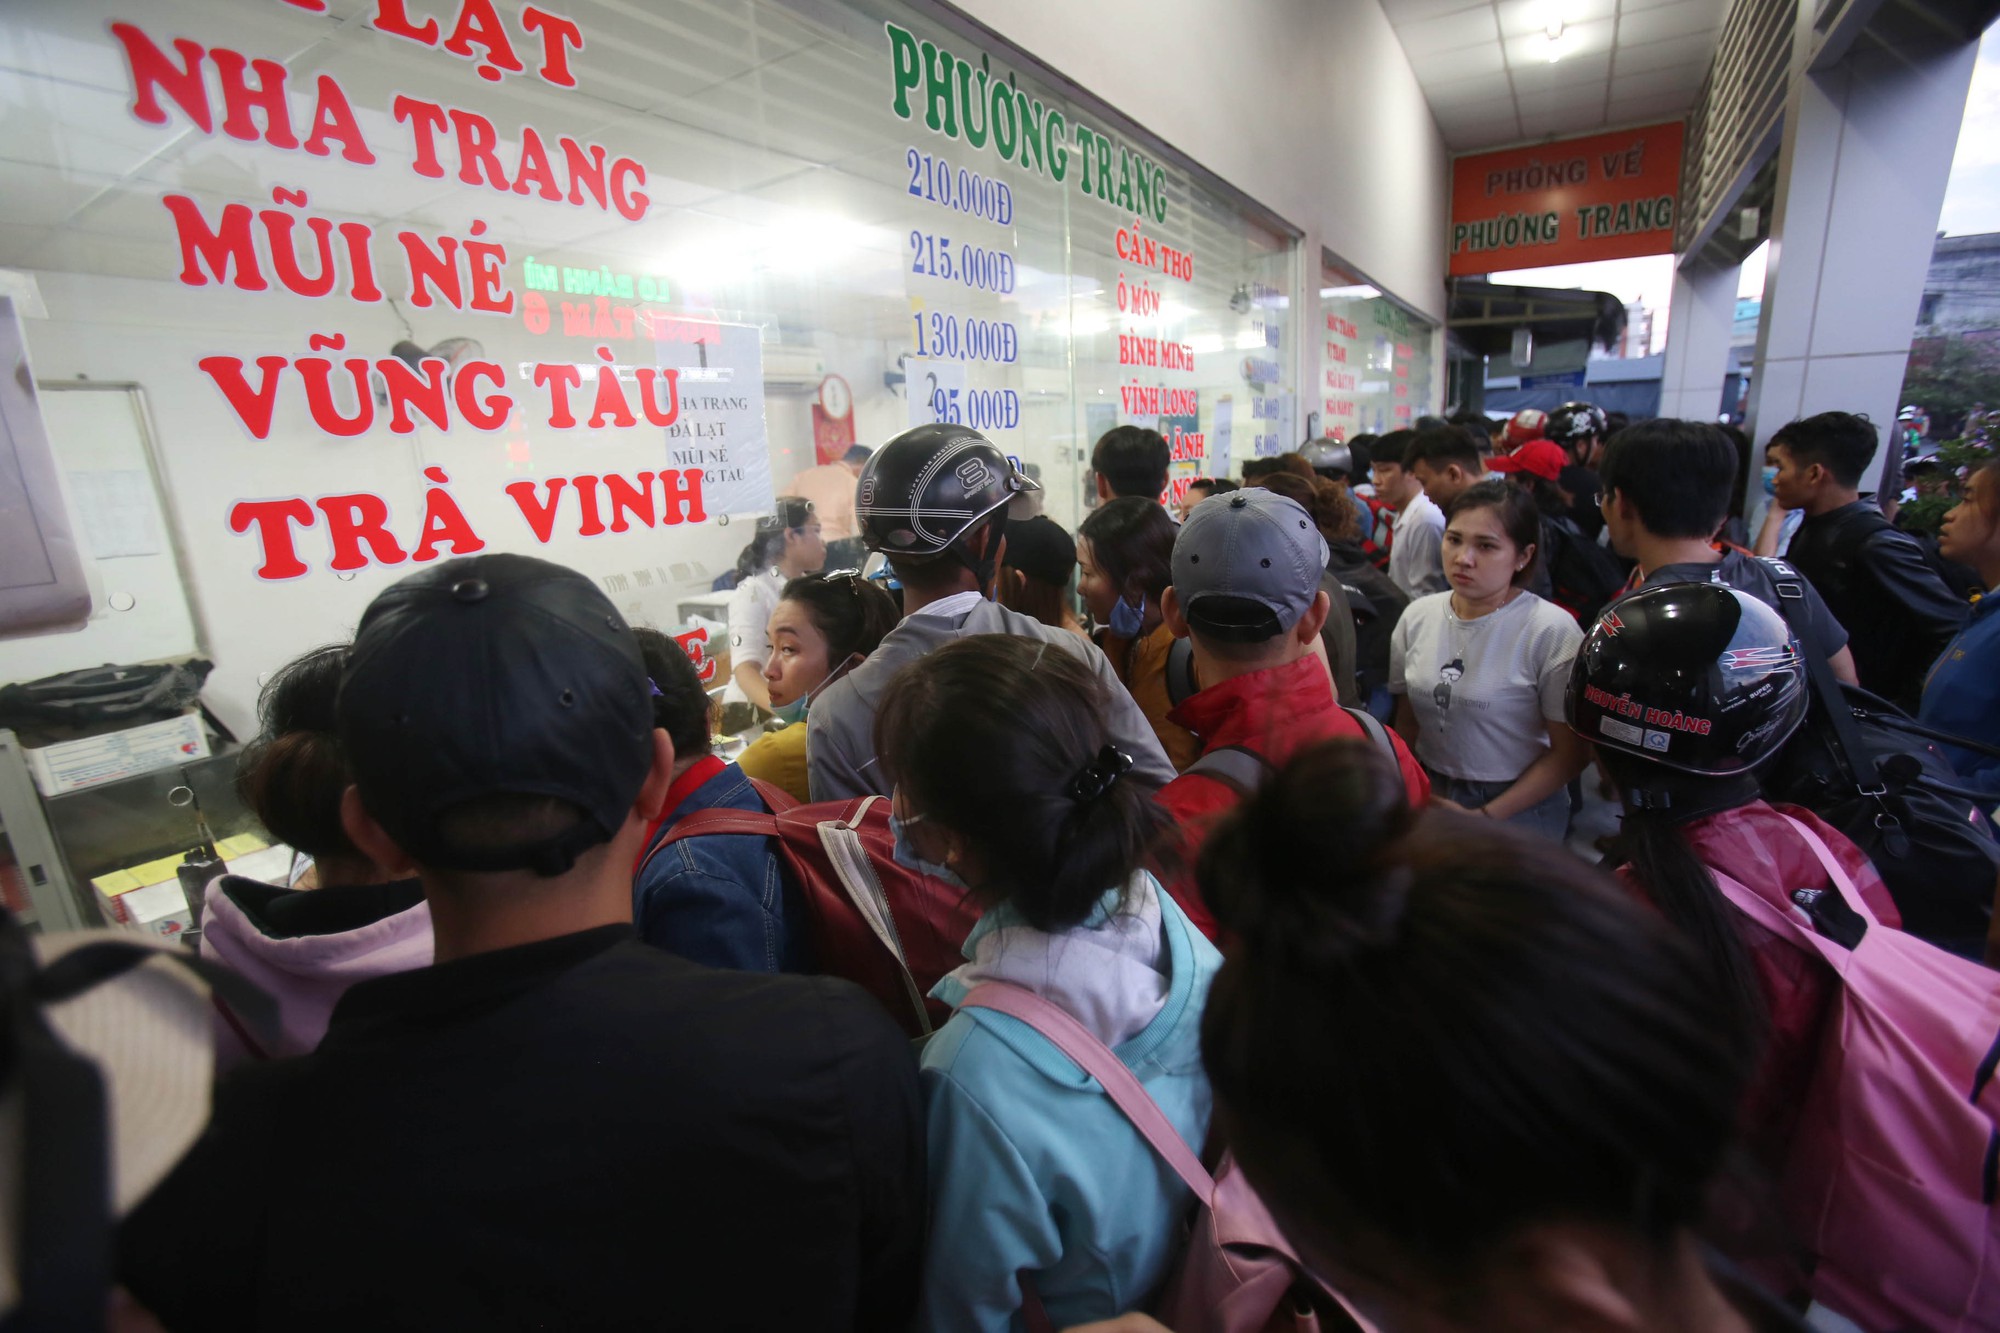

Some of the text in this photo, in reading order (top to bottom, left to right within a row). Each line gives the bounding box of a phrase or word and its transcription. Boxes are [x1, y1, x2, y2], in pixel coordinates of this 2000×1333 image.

[373, 0, 582, 87] LẠT
[111, 22, 650, 222] NHA TRANG
[886, 23, 1168, 224] PHƯƠNG TRANG
[907, 149, 1013, 226] 210.000Đ
[1577, 195, 1674, 240] TRANG
[162, 186, 514, 315] MŨI NÉ
[910, 230, 1015, 295] 215.000Đ
[914, 312, 1018, 364] 130.000Đ
[1161, 340, 1194, 373] MINH
[199, 333, 680, 441] VŨNG TÀU
[704, 397, 748, 411] TRANG
[934, 388, 1020, 430] 95000Đ
[1162, 387, 1198, 416] LONG
[230, 466, 708, 580] TRÀ VINH
[1644, 709, 1712, 736] HOÀNG
